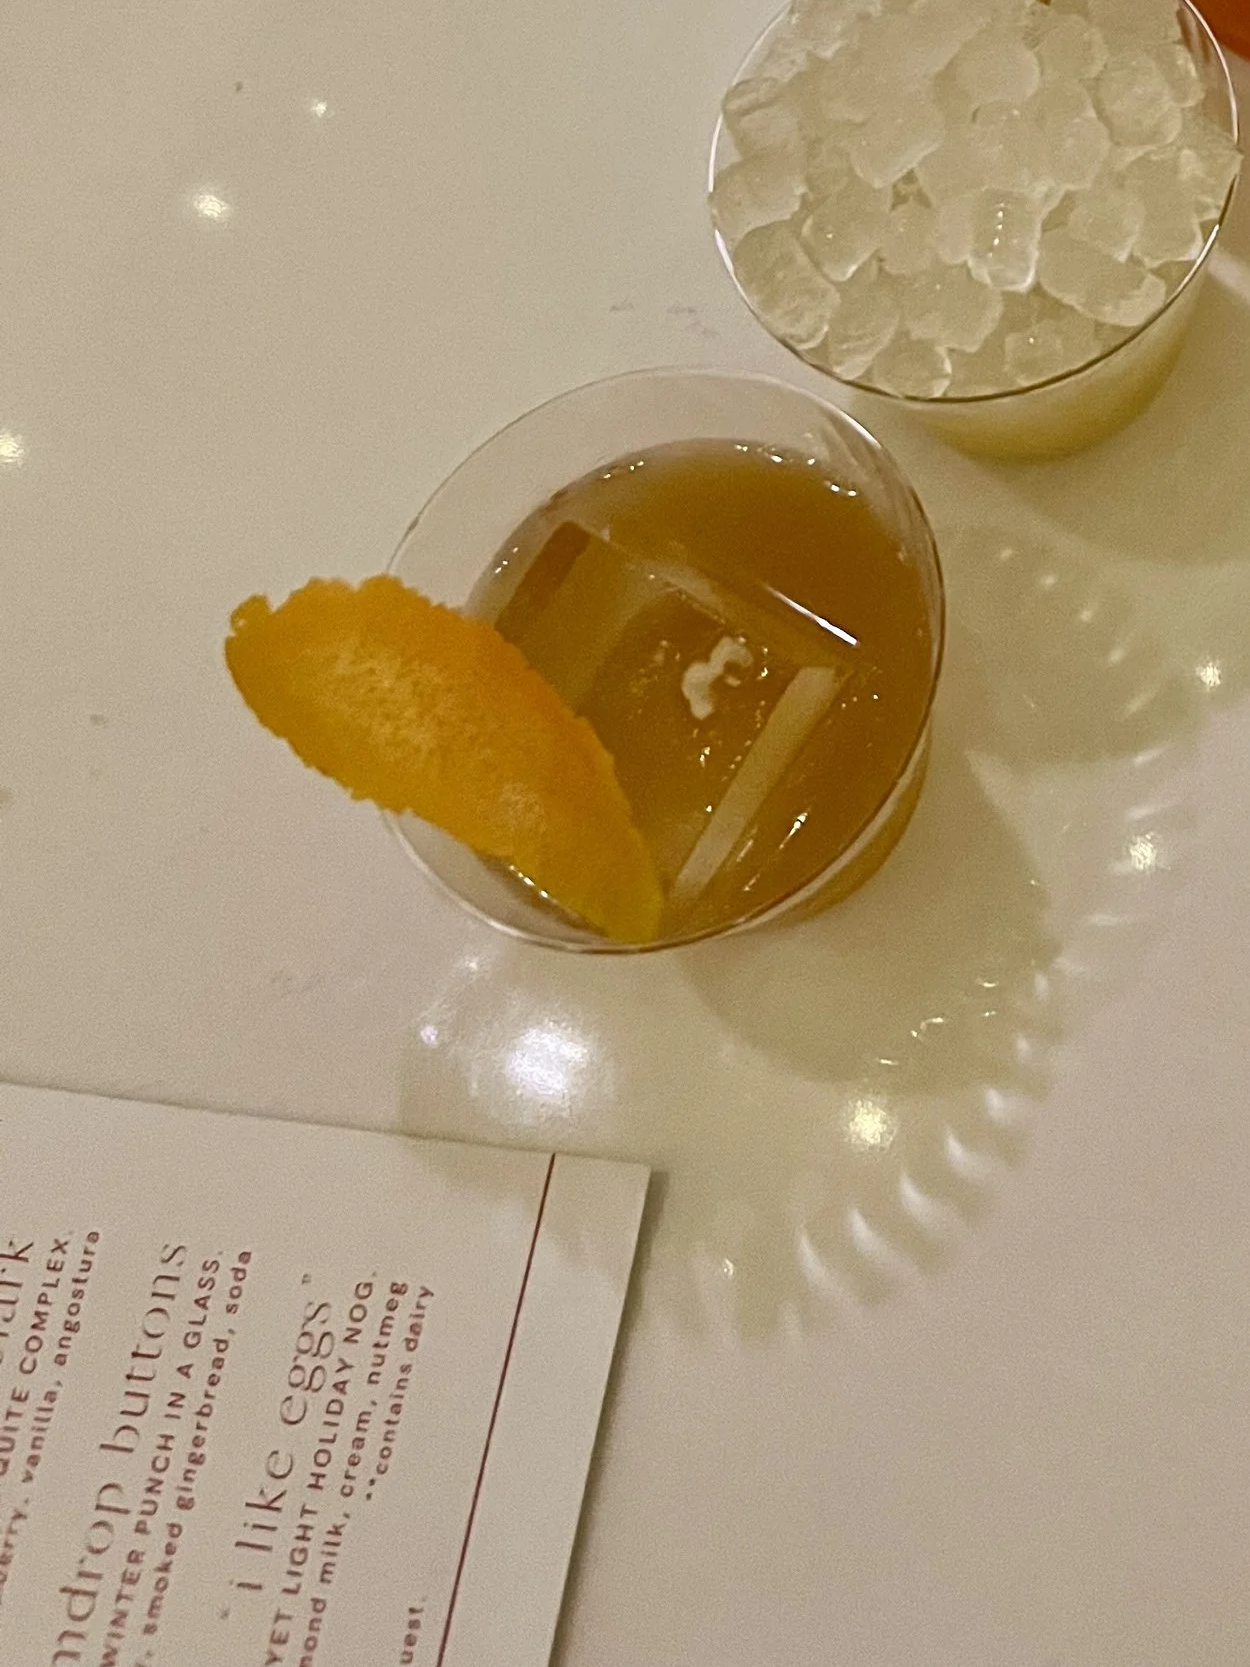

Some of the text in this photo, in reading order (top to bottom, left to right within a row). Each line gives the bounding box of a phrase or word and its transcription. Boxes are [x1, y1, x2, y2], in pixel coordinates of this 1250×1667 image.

[53, 1231, 99, 1366] angostura
[99, 1244, 185, 1453] buttons
[339, 1400, 377, 1498] cream,
[366, 1281, 408, 1385] nutmeg
[403, 1285, 434, 1353] dairy
[0, 1388, 30, 1477] QUITE
[97, 1252, 223, 1667] WINTER PUNCH IN A GLASS.
[142, 1522, 183, 1635] smoked
[175, 1329, 234, 1511] gingerbread,
[225, 1250, 252, 1314] soda
[234, 1450, 294, 1552] like
[264, 1609, 293, 1667] YET
[281, 1503, 317, 1595] LIGHT
[307, 1357, 353, 1491] HOLIDAY
